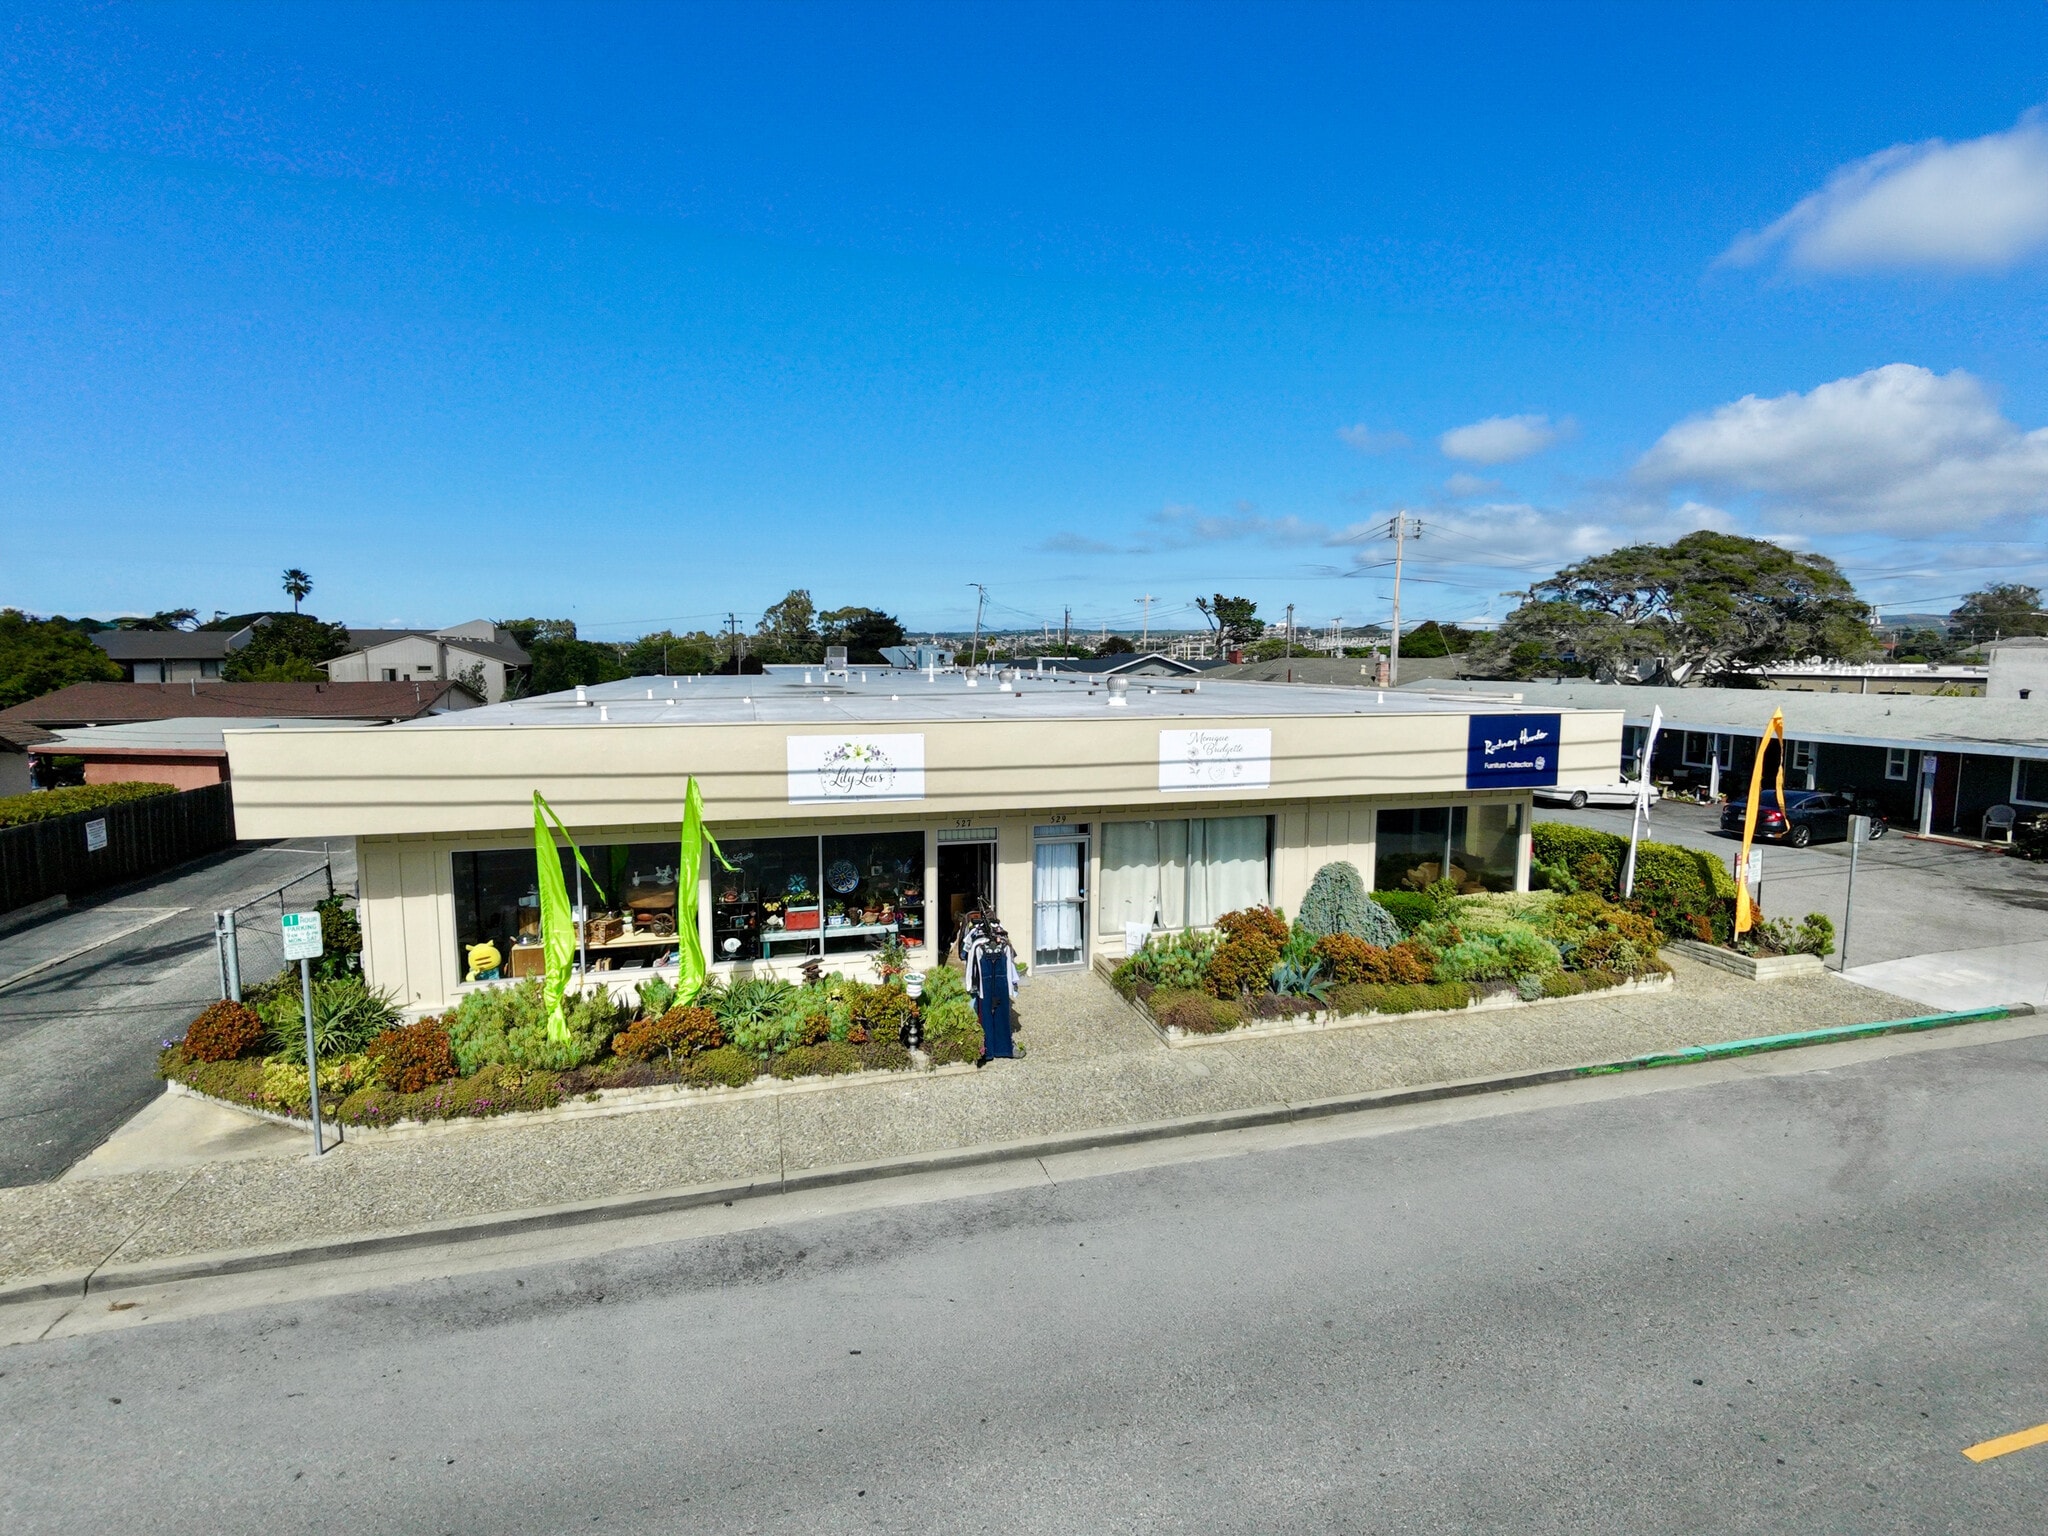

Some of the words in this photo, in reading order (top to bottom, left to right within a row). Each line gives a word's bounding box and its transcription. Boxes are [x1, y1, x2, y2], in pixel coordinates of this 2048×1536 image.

[1187, 732, 1229, 746] Monique
[1484, 739, 1517, 755] Rodney
[1519, 728, 1549, 745] Hunter
[1203, 743, 1244, 757] Bridgette
[829, 765, 855, 793] Lily
[956, 819, 972, 828] 527
[1050, 815, 1067, 824] 529
